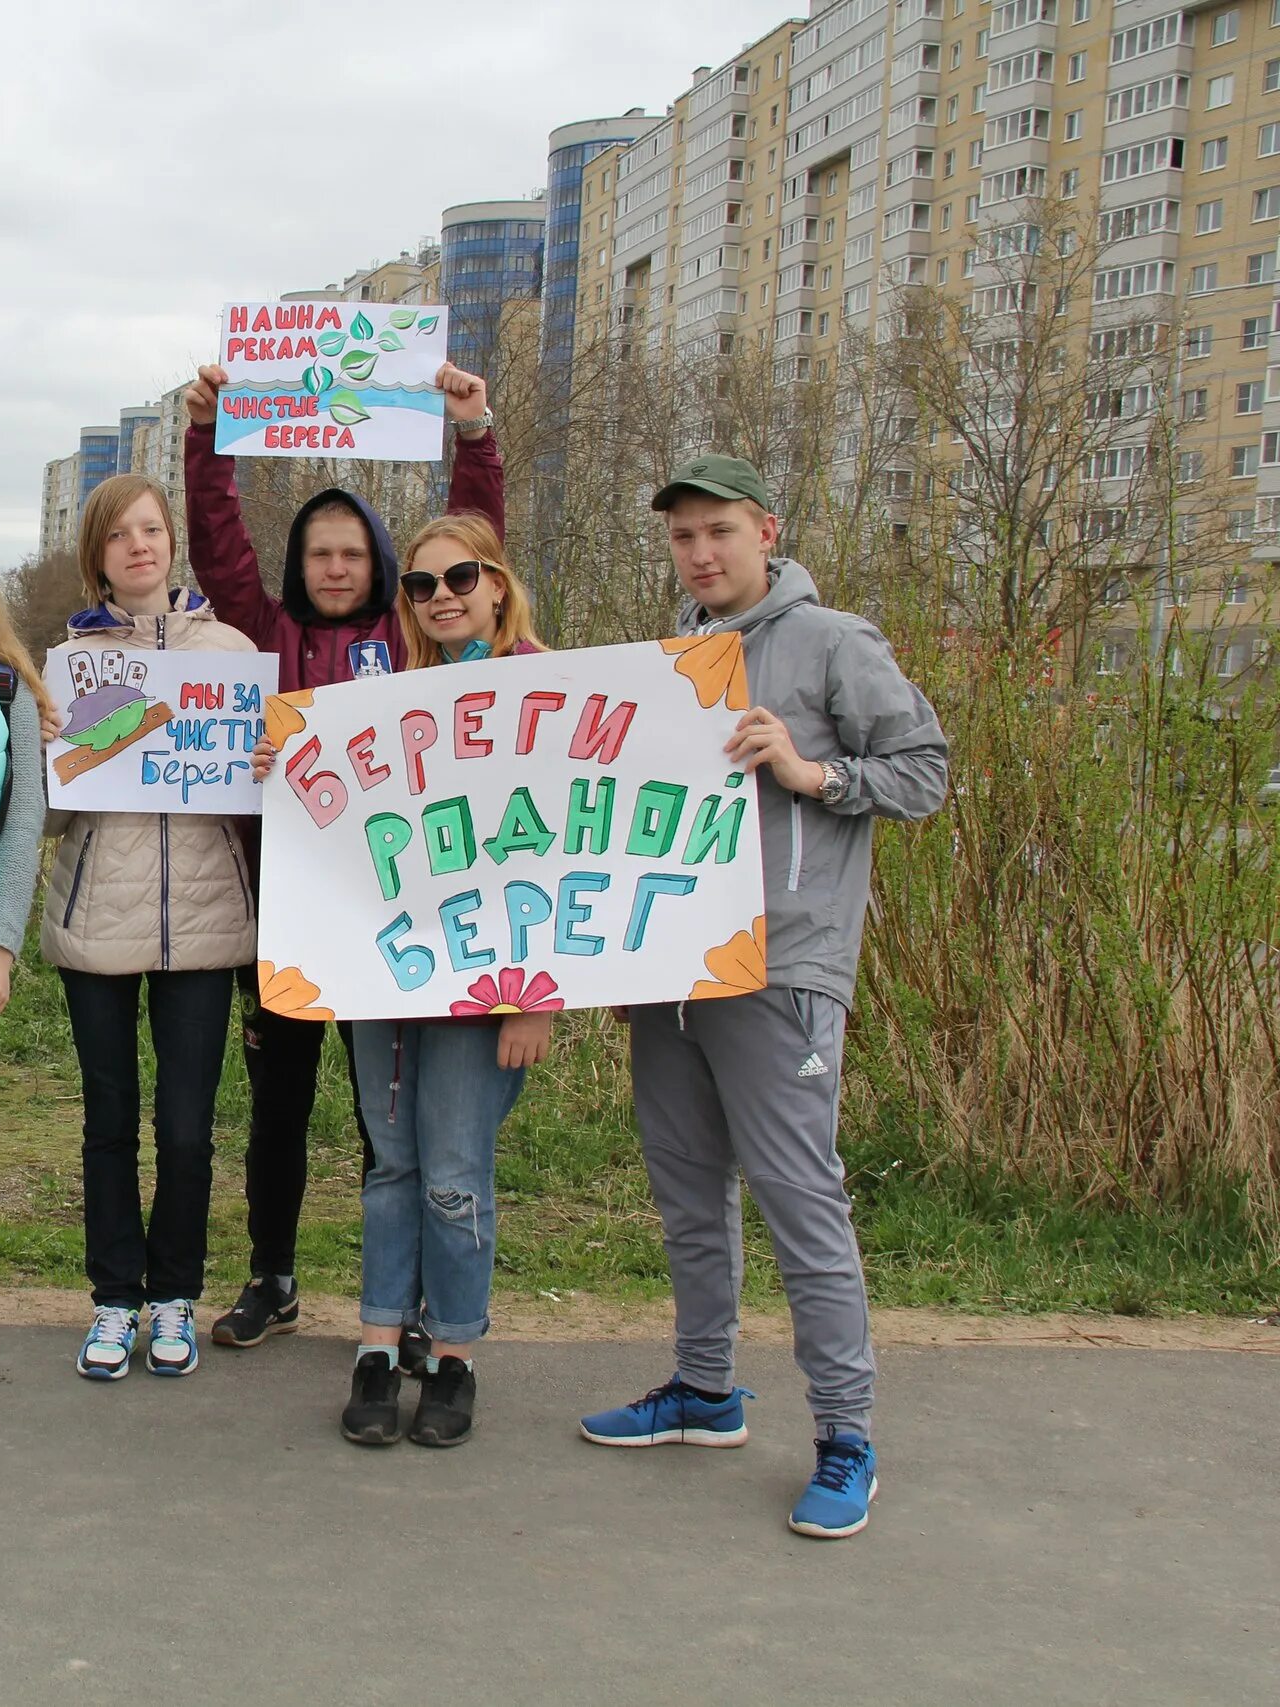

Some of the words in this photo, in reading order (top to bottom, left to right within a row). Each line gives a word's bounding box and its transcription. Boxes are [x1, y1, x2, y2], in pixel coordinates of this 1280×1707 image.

[229, 304, 342, 333] НАШИМ
[227, 336, 318, 363] РЕКАМ
[223, 396, 320, 419] ЧИСТЫЕ
[264, 425, 356, 448] БЕРЕГА
[179, 682, 224, 710] МЫ
[232, 683, 261, 713] ЗА
[166, 718, 266, 753] ЧИСТЫ
[285, 690, 637, 830] БЕРЕГИ
[141, 750, 263, 804] Берег
[364, 771, 747, 901] РОДНОЙ
[375, 870, 698, 992] БЕРЕГ
[797, 1066, 829, 1077] adidas
